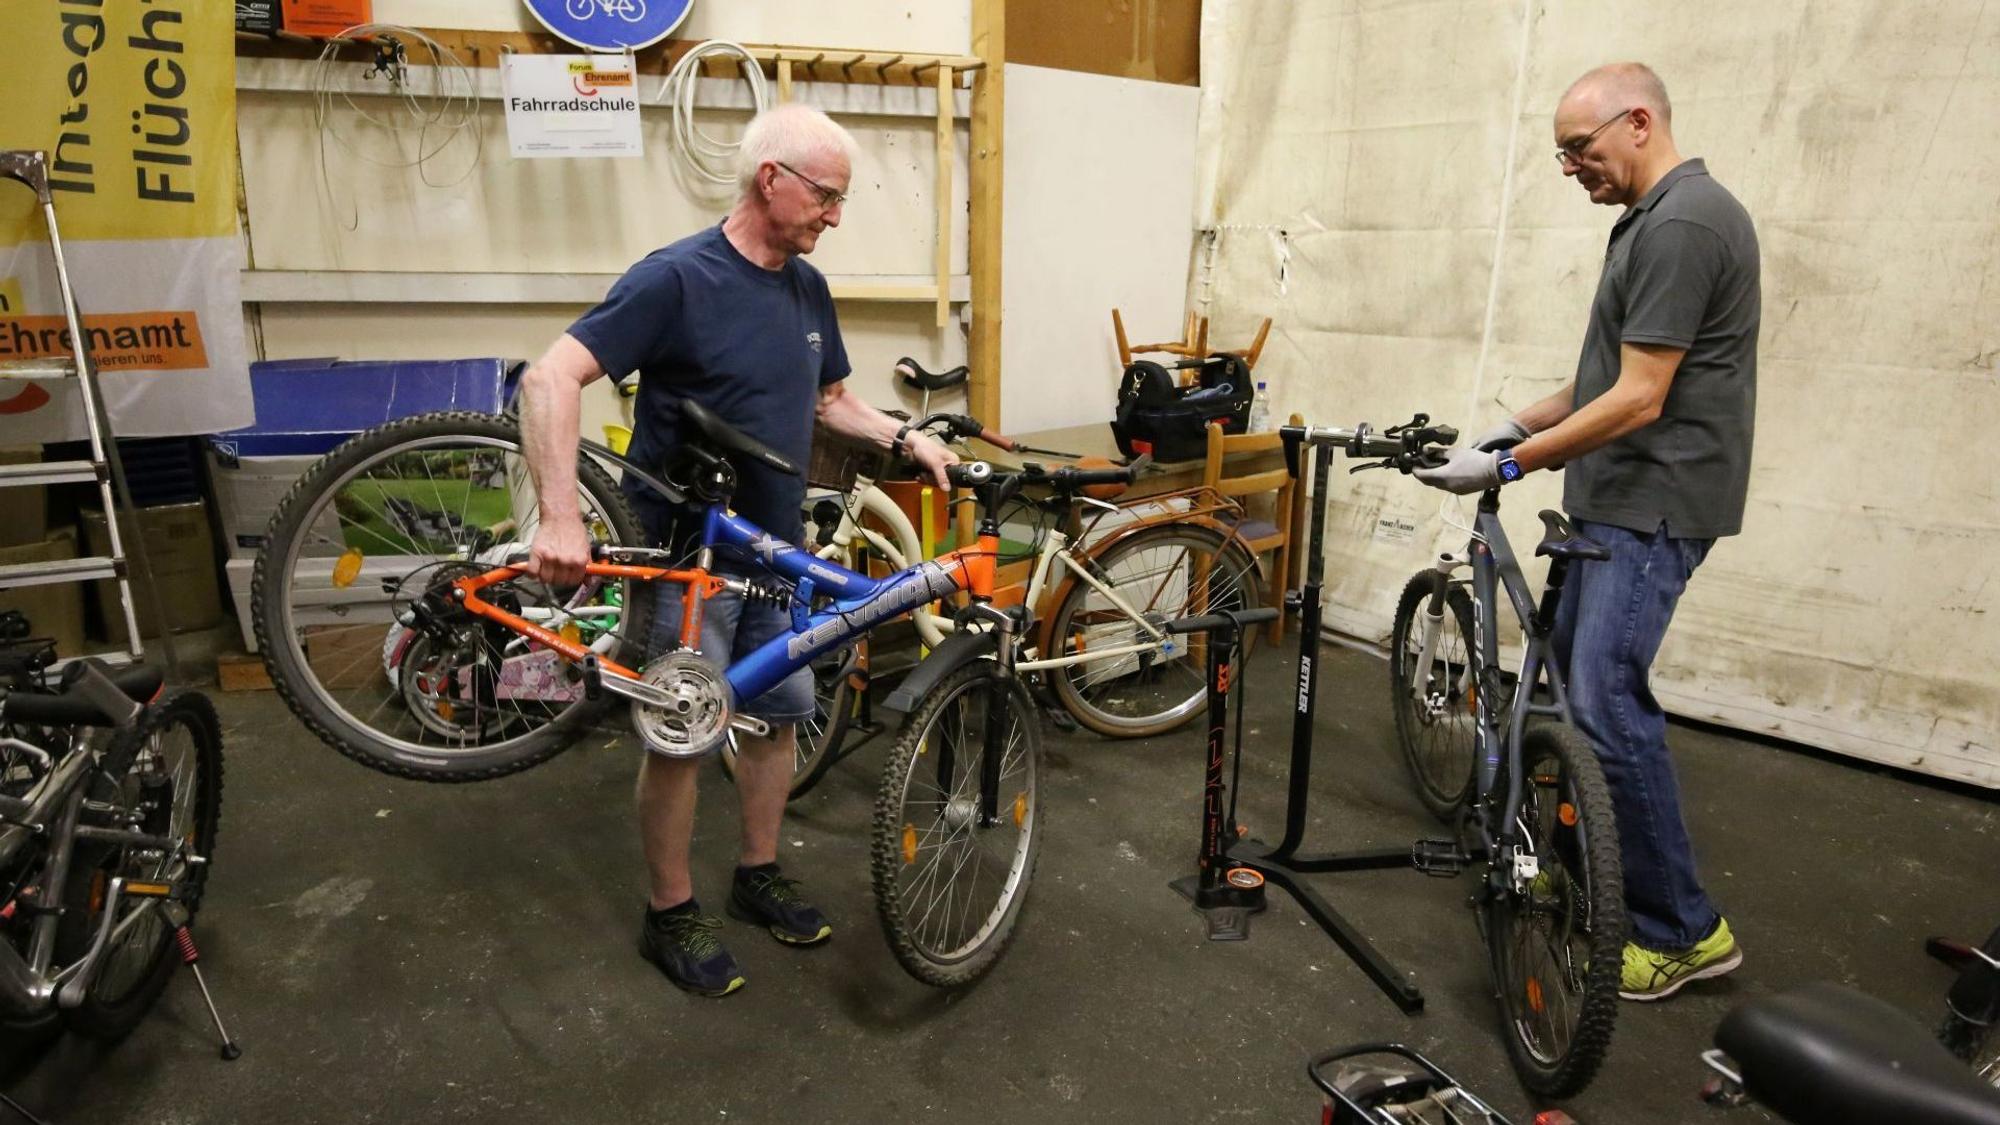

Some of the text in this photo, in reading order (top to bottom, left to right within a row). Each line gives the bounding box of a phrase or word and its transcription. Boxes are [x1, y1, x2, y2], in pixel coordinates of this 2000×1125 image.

[569, 63, 592, 71] Forum
[585, 72, 631, 82] Ehrenamt
[128, 0, 195, 203] Flüch
[511, 97, 635, 112] Fahrradschule
[1298, 655, 1311, 714] KETTLER
